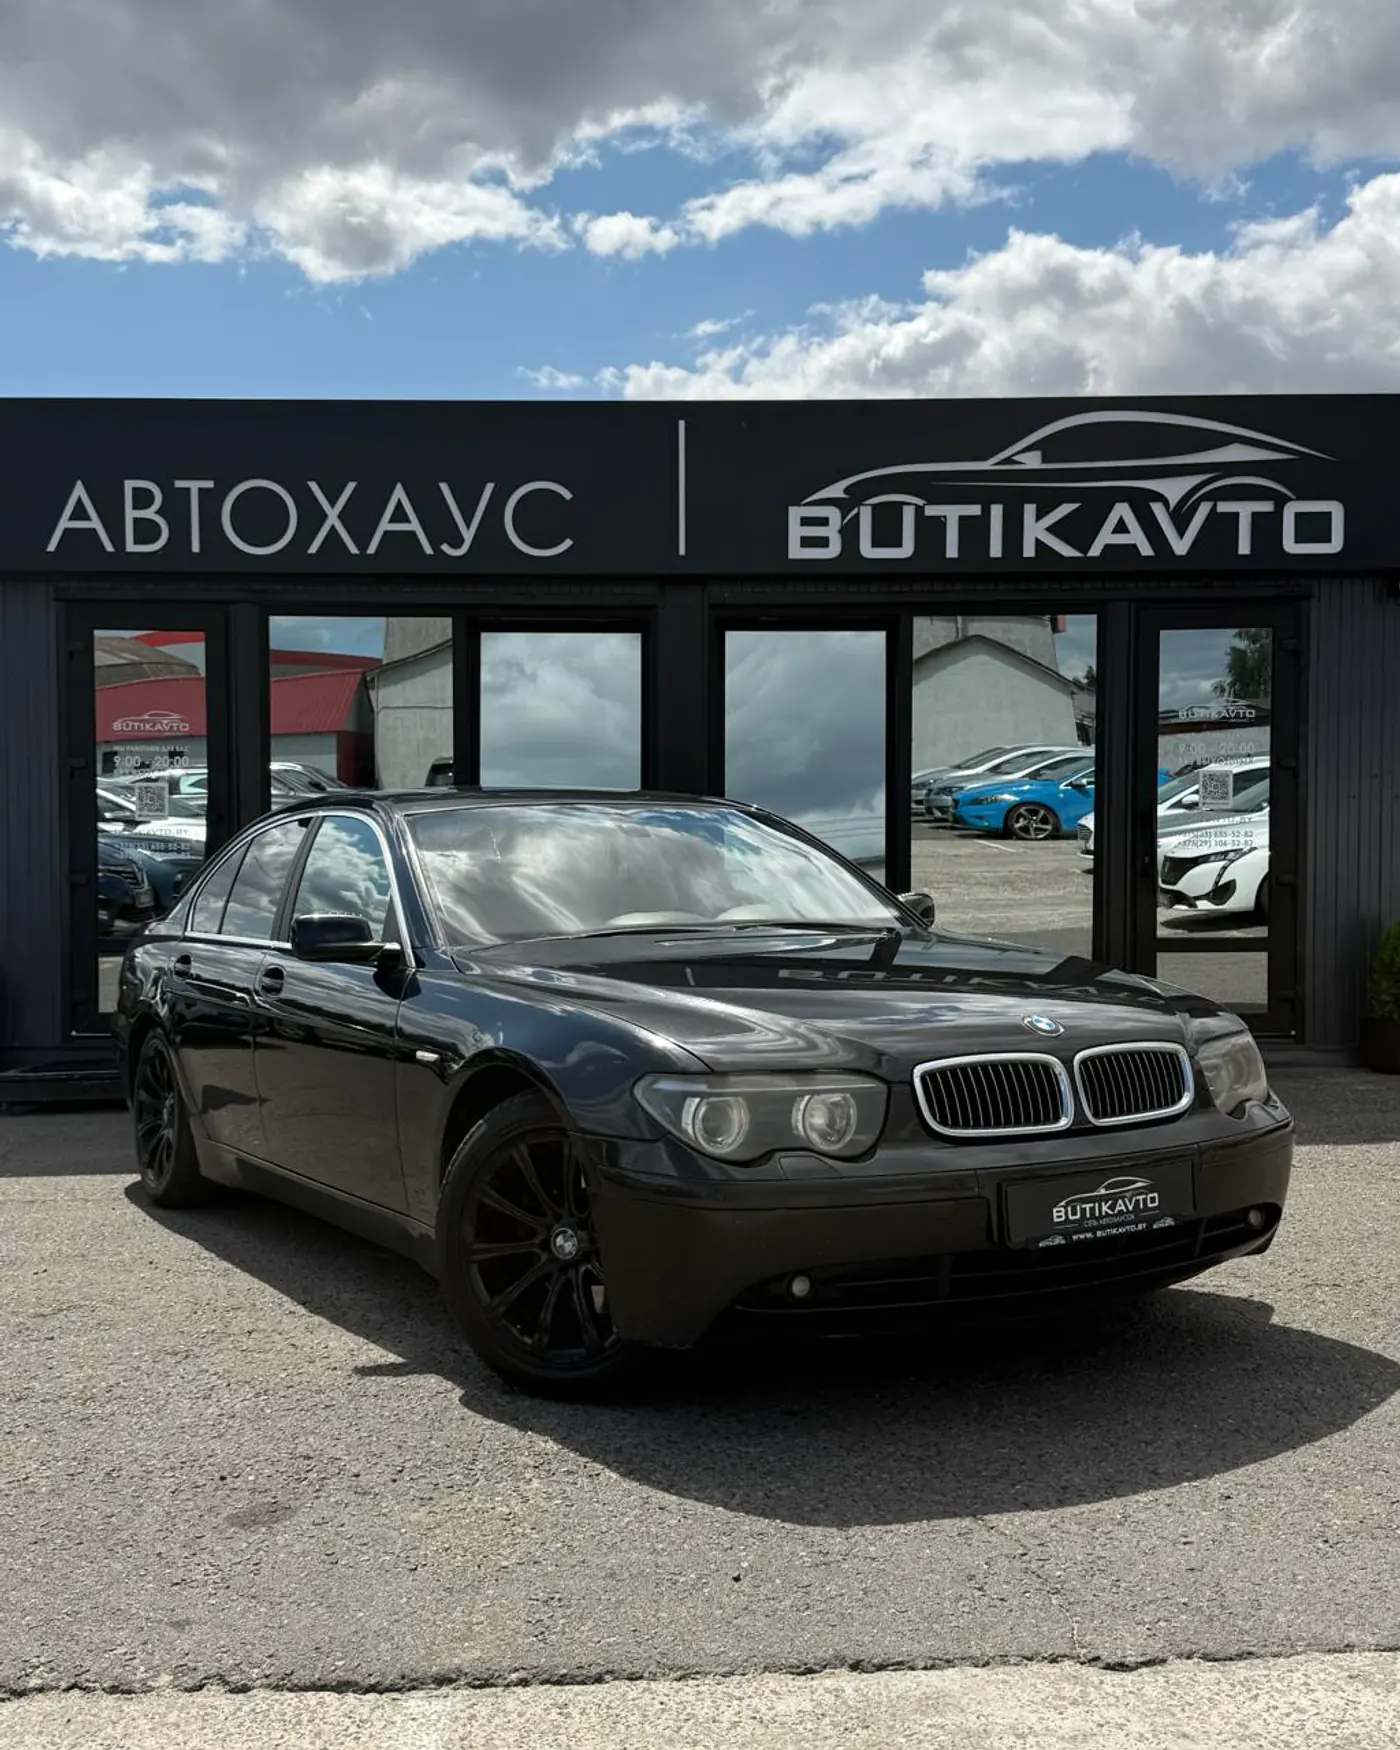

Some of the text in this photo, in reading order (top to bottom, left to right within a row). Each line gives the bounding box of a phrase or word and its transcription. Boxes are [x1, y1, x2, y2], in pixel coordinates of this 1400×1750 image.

[46, 479, 574, 557] АВТОХАУС
[788, 500, 1345, 560] BUTIKAVTO
[112, 721, 190, 732] BUTIKAVTO
[154, 755, 190, 768] 20:00
[1052, 1192, 1160, 1222] BUTIKAVTO
